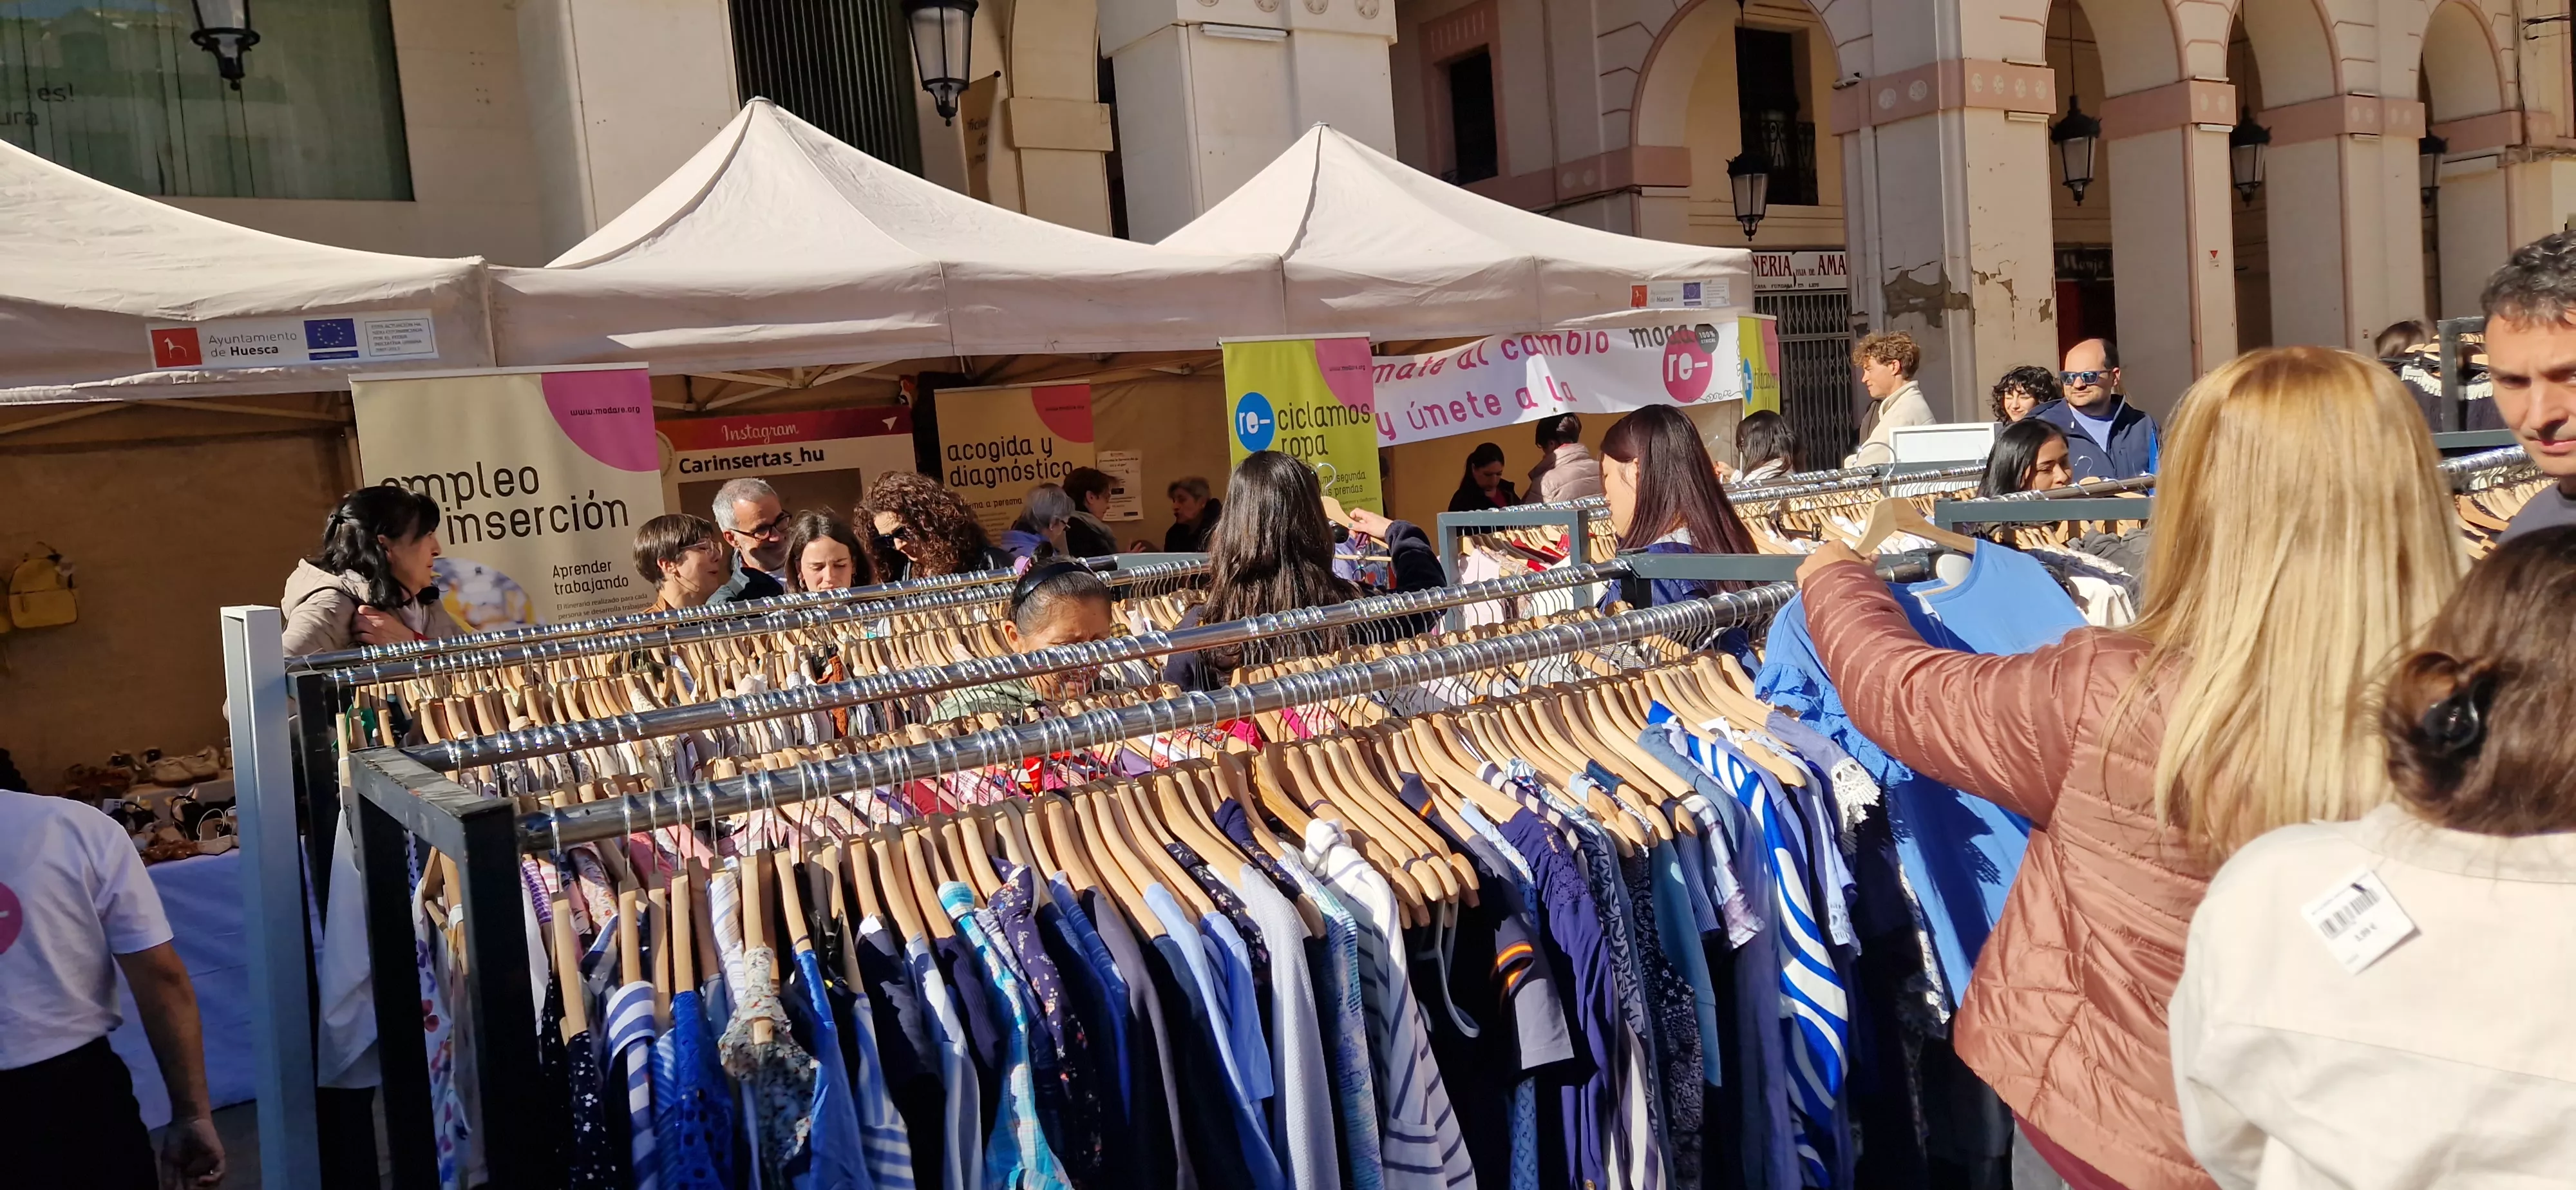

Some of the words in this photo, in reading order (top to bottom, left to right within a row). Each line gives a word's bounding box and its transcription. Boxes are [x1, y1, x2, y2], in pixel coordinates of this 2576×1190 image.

[37, 82, 75, 102] es!
[209, 332, 298, 346] Ayuntamiento
[211, 346, 226, 358] de
[231, 345, 279, 357] Huesca
[1457, 341, 1489, 370] al
[1501, 330, 1609, 361] cambio
[1668, 353, 1708, 382] re-
[570, 405, 640, 416] www.modare.org
[1239, 411, 1271, 435] re-
[1278, 401, 1371, 431] ciclamos
[1376, 411, 1397, 440] y
[1406, 392, 1502, 431] únete
[1515, 386, 1539, 410] a
[1545, 375, 1578, 402] la
[722, 423, 799, 444] Instagram
[947, 435, 1034, 463] acogida
[1041, 437, 1053, 458] y
[1282, 434, 1329, 462] ropa
[679, 447, 824, 474] Carinsertas_hu
[950, 458, 1074, 489] diagnóstico
[1336, 470, 1366, 484] segunda
[1334, 484, 1363, 497] prendas
[445, 489, 629, 545] inserción
[553, 560, 612, 580] Aprender
[554, 574, 629, 596] trabajando
[558, 612, 582, 620] persona
[591, 606, 621, 616] desarrolla
[622, 601, 653, 612] trabajando
[564, 600, 591, 609] itinerario
[592, 597, 620, 607] realizado
